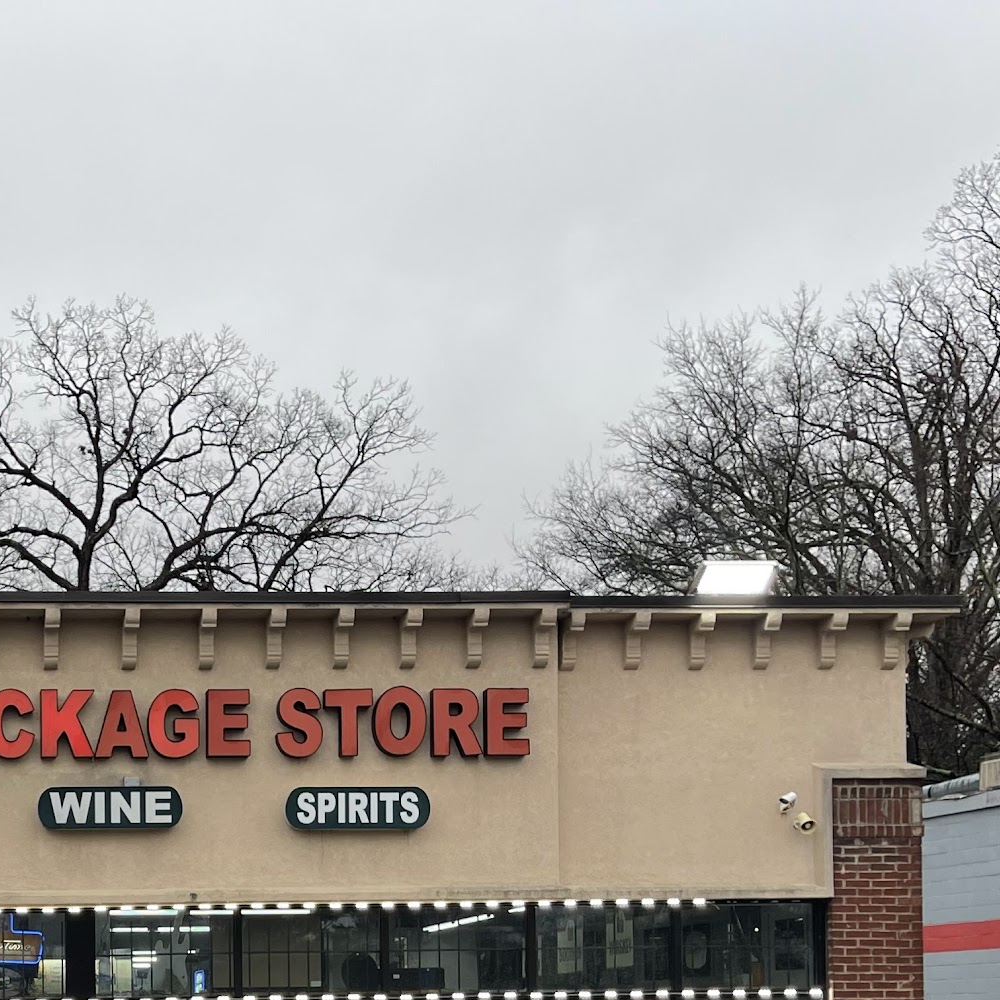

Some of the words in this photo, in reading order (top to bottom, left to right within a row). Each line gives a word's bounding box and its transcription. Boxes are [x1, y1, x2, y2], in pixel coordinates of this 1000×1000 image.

[275, 685, 530, 759] STORE
[50, 791, 172, 824] WINE
[297, 791, 420, 825] SPIRITS
